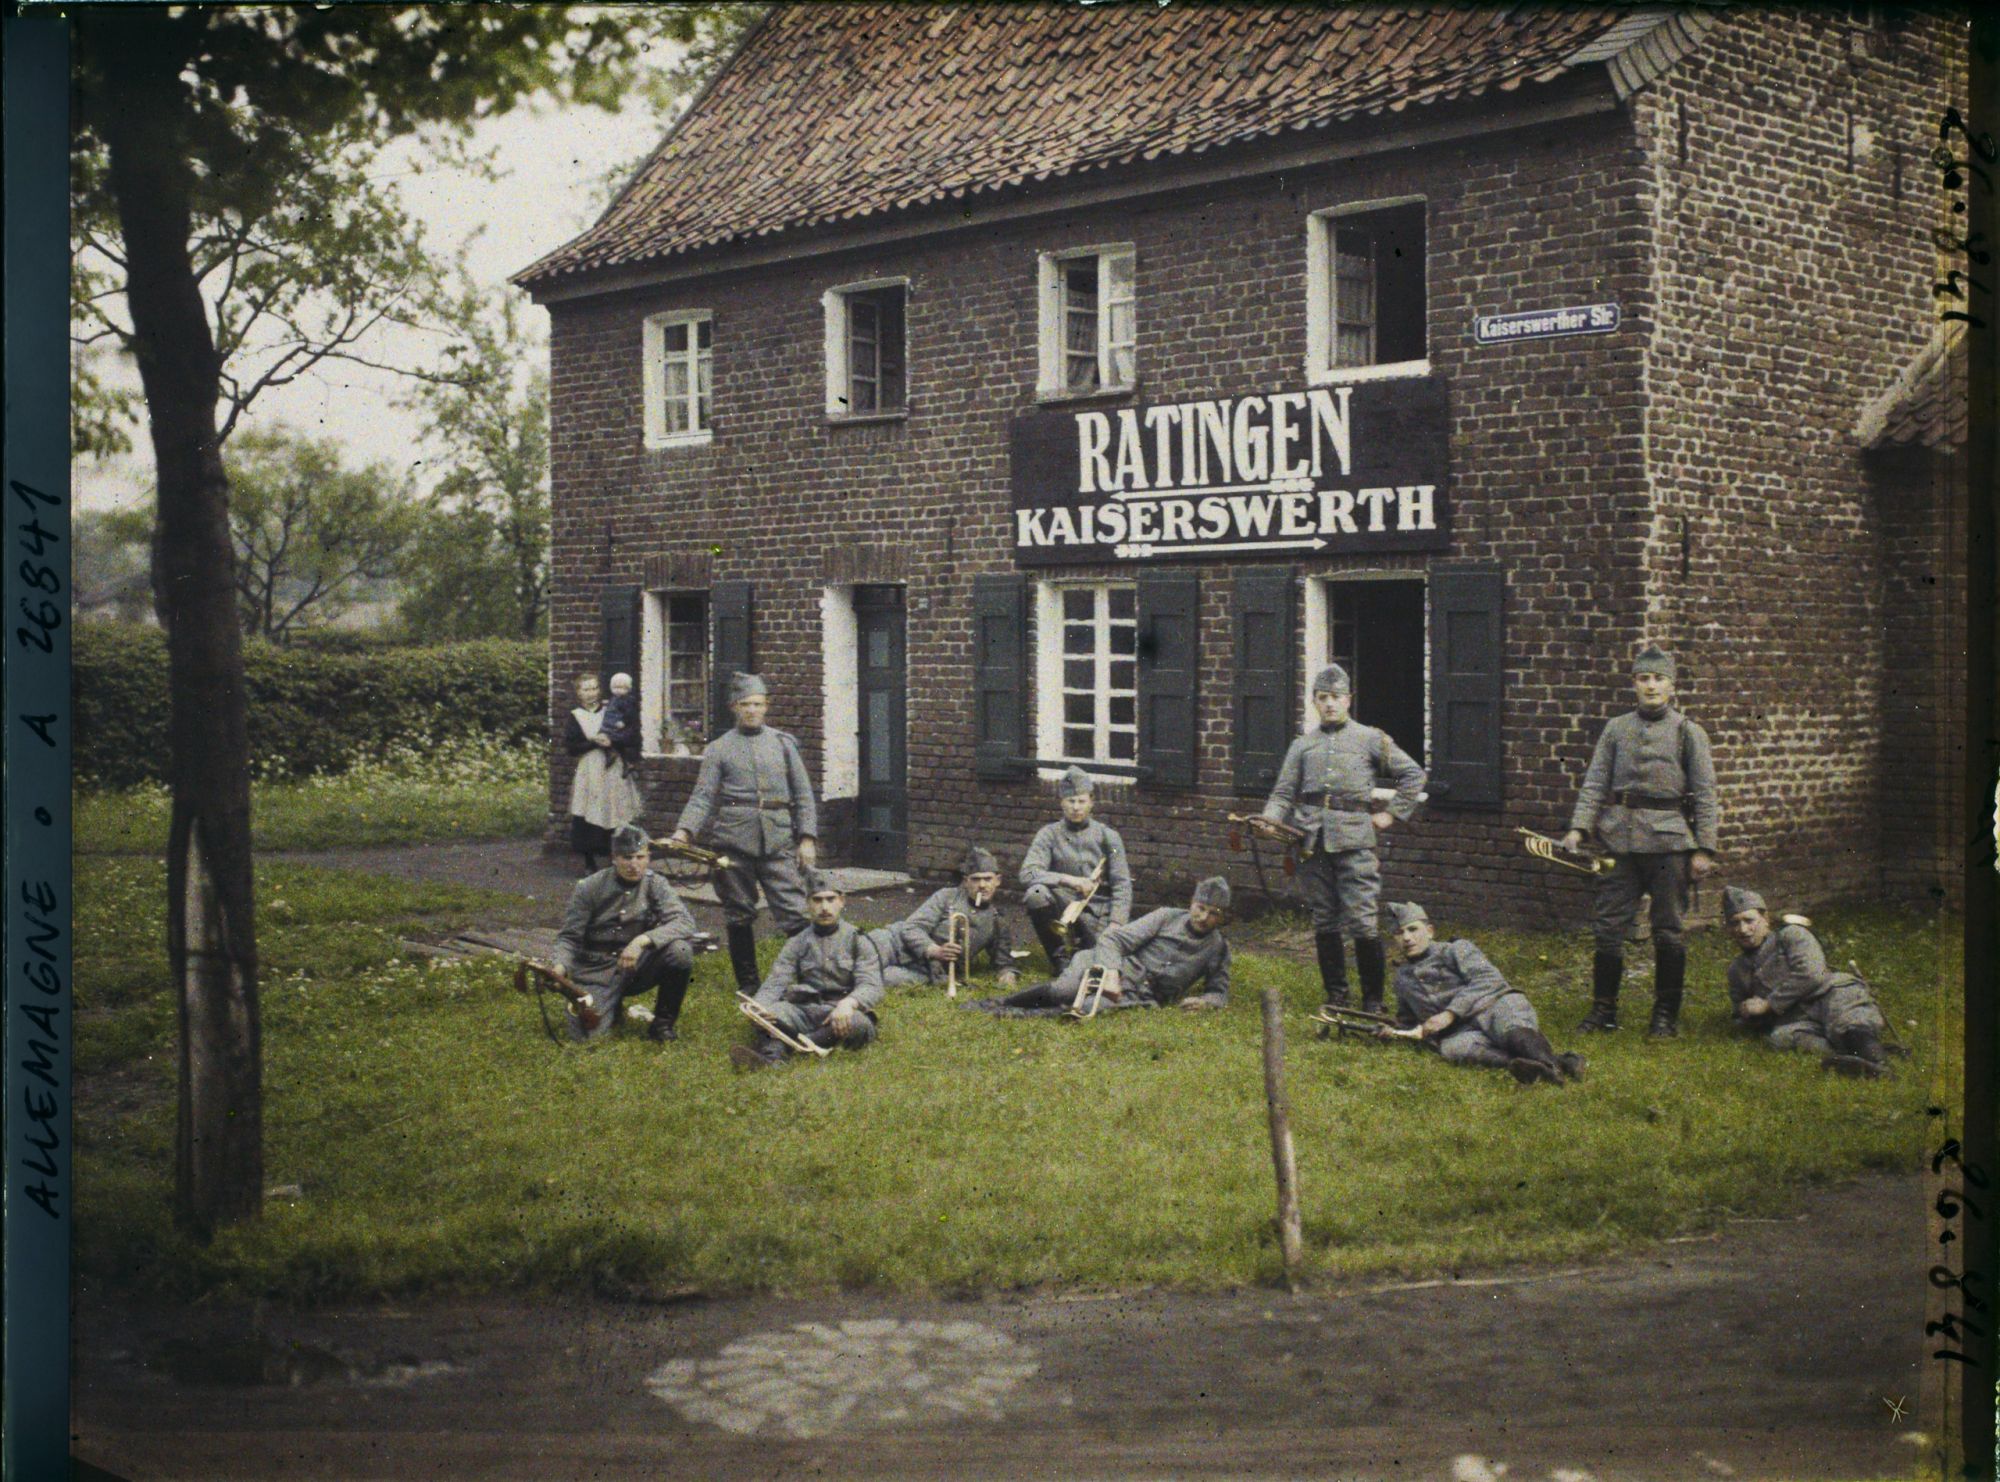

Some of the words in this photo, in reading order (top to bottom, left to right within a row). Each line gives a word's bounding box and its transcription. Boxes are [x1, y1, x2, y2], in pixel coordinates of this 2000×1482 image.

[1480, 310, 1587, 338] Kaiserswerther
[1075, 387, 1353, 493] RATINGEN
[1016, 485, 1437, 547] KAISERSWERTH
[10, 480, 62, 654] 26841
[19, 713, 58, 748] A
[20, 879, 61, 1220] ALLEMAGNE
